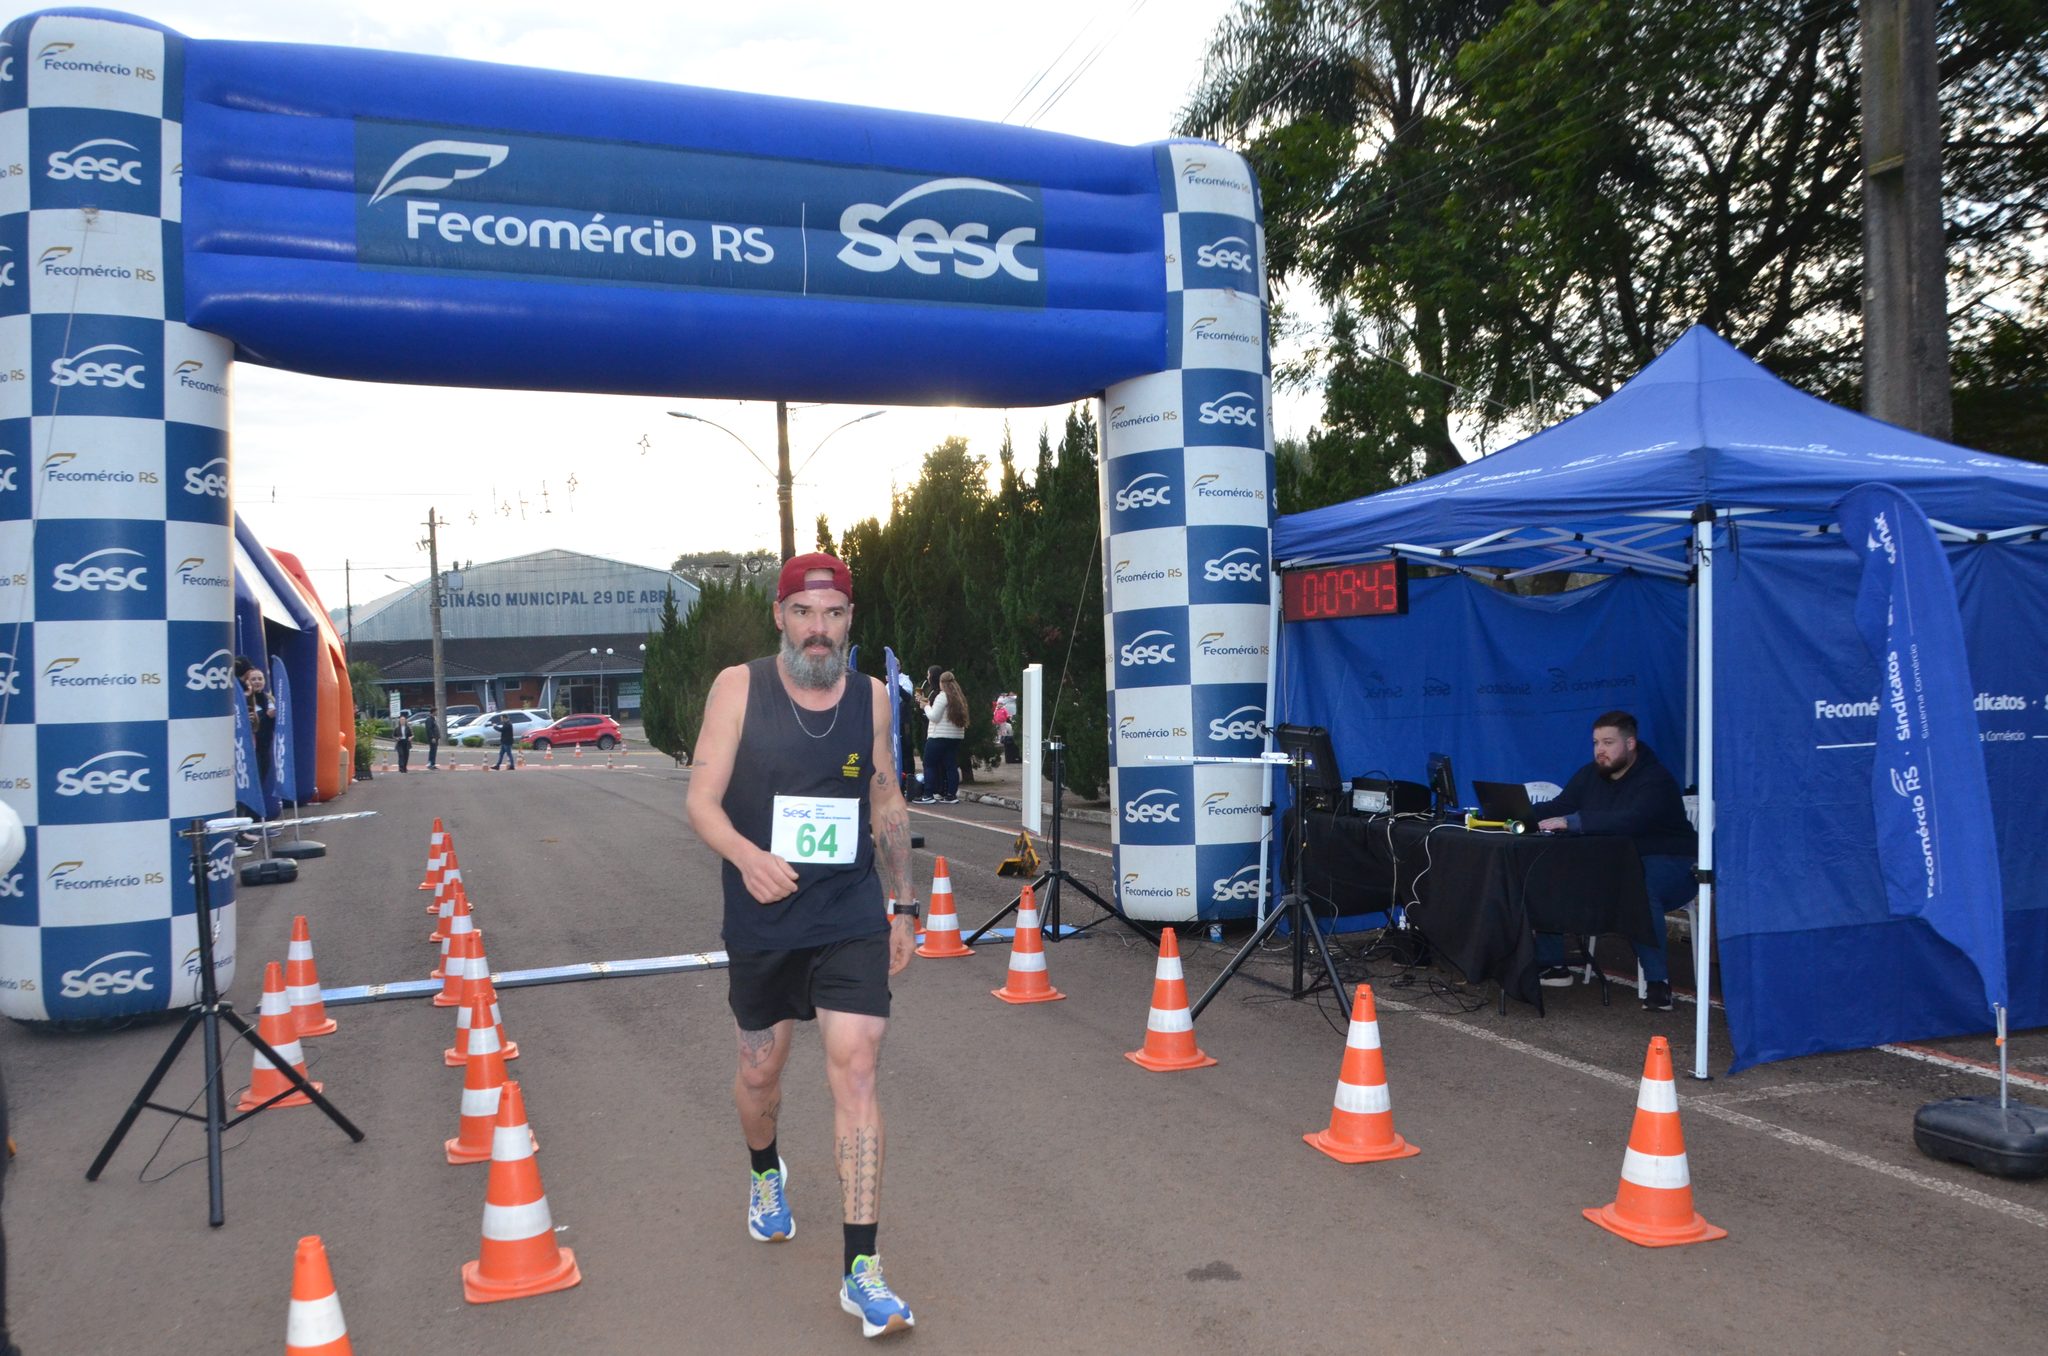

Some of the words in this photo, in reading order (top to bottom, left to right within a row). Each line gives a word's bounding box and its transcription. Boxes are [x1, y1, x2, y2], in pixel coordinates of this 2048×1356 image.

[44, 59, 131, 77] Fecomércio
[135, 67, 156, 81] RS
[47, 151, 142, 186] Sesc
[1188, 175, 1241, 190] Fecomércio
[406, 199, 697, 258] Fecomércio
[712, 224, 775, 266] RS
[836, 203, 1040, 282] Sesc
[1197, 245, 1252, 274] Sesc
[45, 264, 131, 279] Fecomércio
[136, 268, 156, 282] RS
[1196, 331, 1250, 343] Fecomércio
[50, 358, 145, 389] Sesc
[1111, 413, 1160, 431] Fecomércio
[1162, 411, 1178, 421] RS
[1199, 401, 1257, 427] Sesc
[48, 470, 134, 483] Fecomércio
[139, 472, 159, 484] RS
[1115, 485, 1171, 512] Sesc
[1199, 487, 1254, 499] Fecomércio
[1874, 511, 1897, 565] Senac
[52, 563, 148, 592] Sesc
[1116, 570, 1165, 584] Fecomércio
[1167, 568, 1183, 578] RS
[1203, 559, 1262, 582] Sesc
[438, 590, 501, 608] GINÁSIO
[506, 590, 589, 606] MUNICIPAL
[593, 590, 612, 604] 29
[617, 589, 635, 604] DE
[640, 588, 680, 603] ABRL
[1120, 643, 1176, 667] Sesc
[1203, 646, 1259, 656] Fecomércio
[51, 674, 137, 687] Fecomércio
[141, 673, 161, 685] RS
[1909, 643, 1922, 693] Comércio
[1815, 695, 1882, 719] Fecomé
[1887, 651, 1910, 741] Sindicatos
[1915, 695, 1930, 739] Sistema
[1121, 727, 1169, 740] Fecomércio
[1172, 727, 1187, 738] RS
[55, 768, 151, 797] Sesc
[1903, 765, 1922, 792] RS
[783, 807, 812, 819] Sesc
[1125, 801, 1180, 823] Sesc
[796, 823, 838, 858] 64
[1911, 795, 1935, 899] Fecomércio
[55, 877, 140, 891] Fecomércio
[144, 872, 165, 885] RS
[1125, 886, 1173, 898] Fecomércio
[1176, 887, 1191, 898] RS
[60, 967, 154, 999] Sesc
